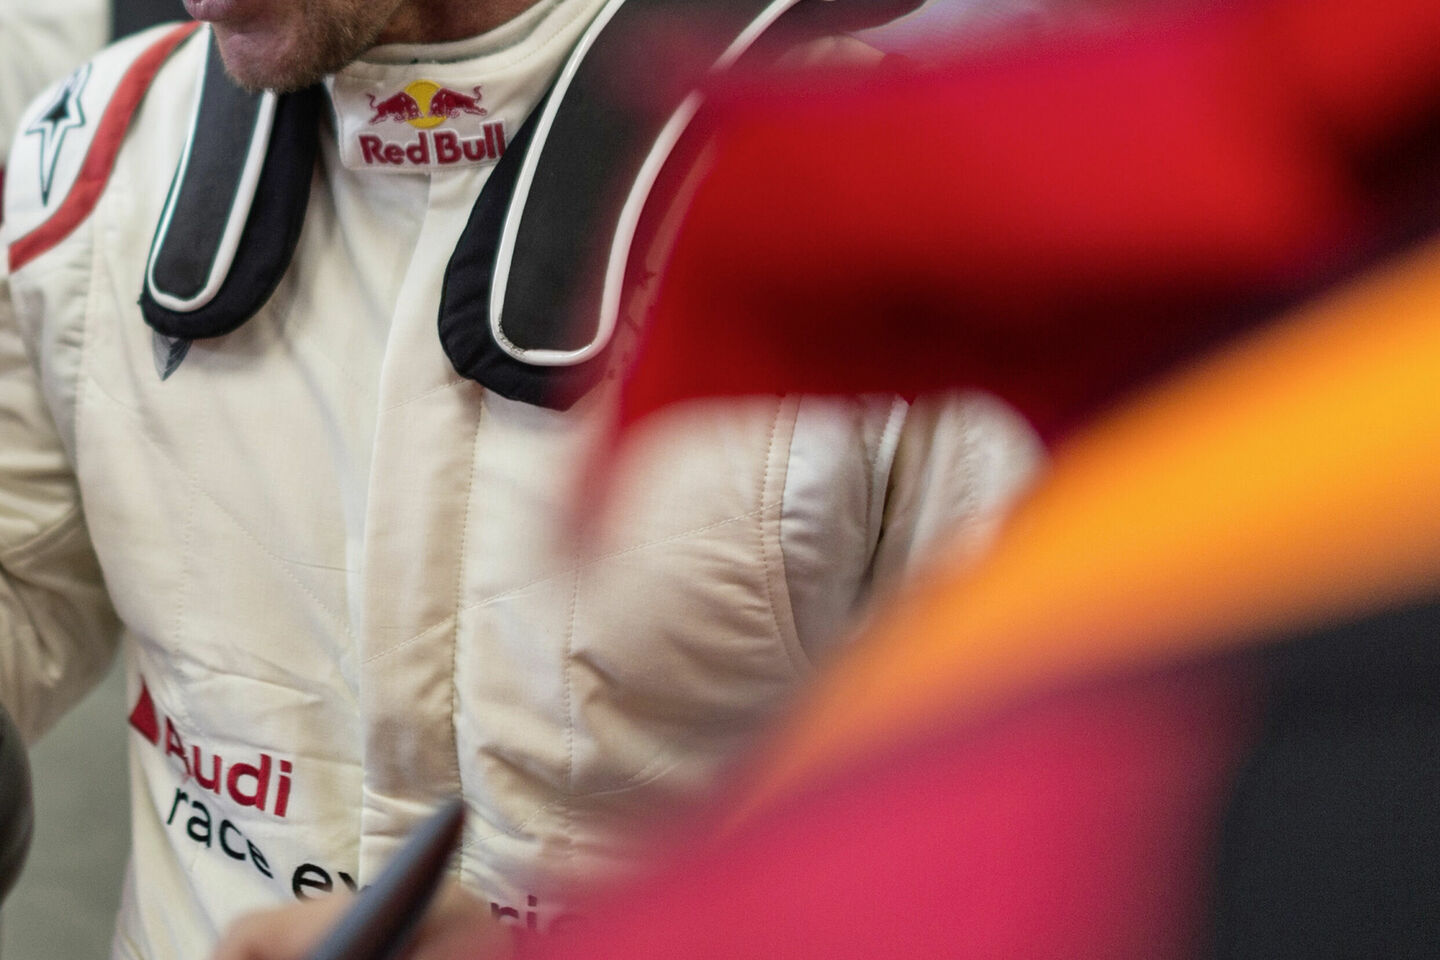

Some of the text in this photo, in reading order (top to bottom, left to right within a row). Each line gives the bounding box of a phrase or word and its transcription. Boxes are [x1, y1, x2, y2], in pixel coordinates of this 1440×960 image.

[358, 122, 506, 165] Red Bull
[164, 715, 292, 818] Audi
[166, 787, 274, 880] race
